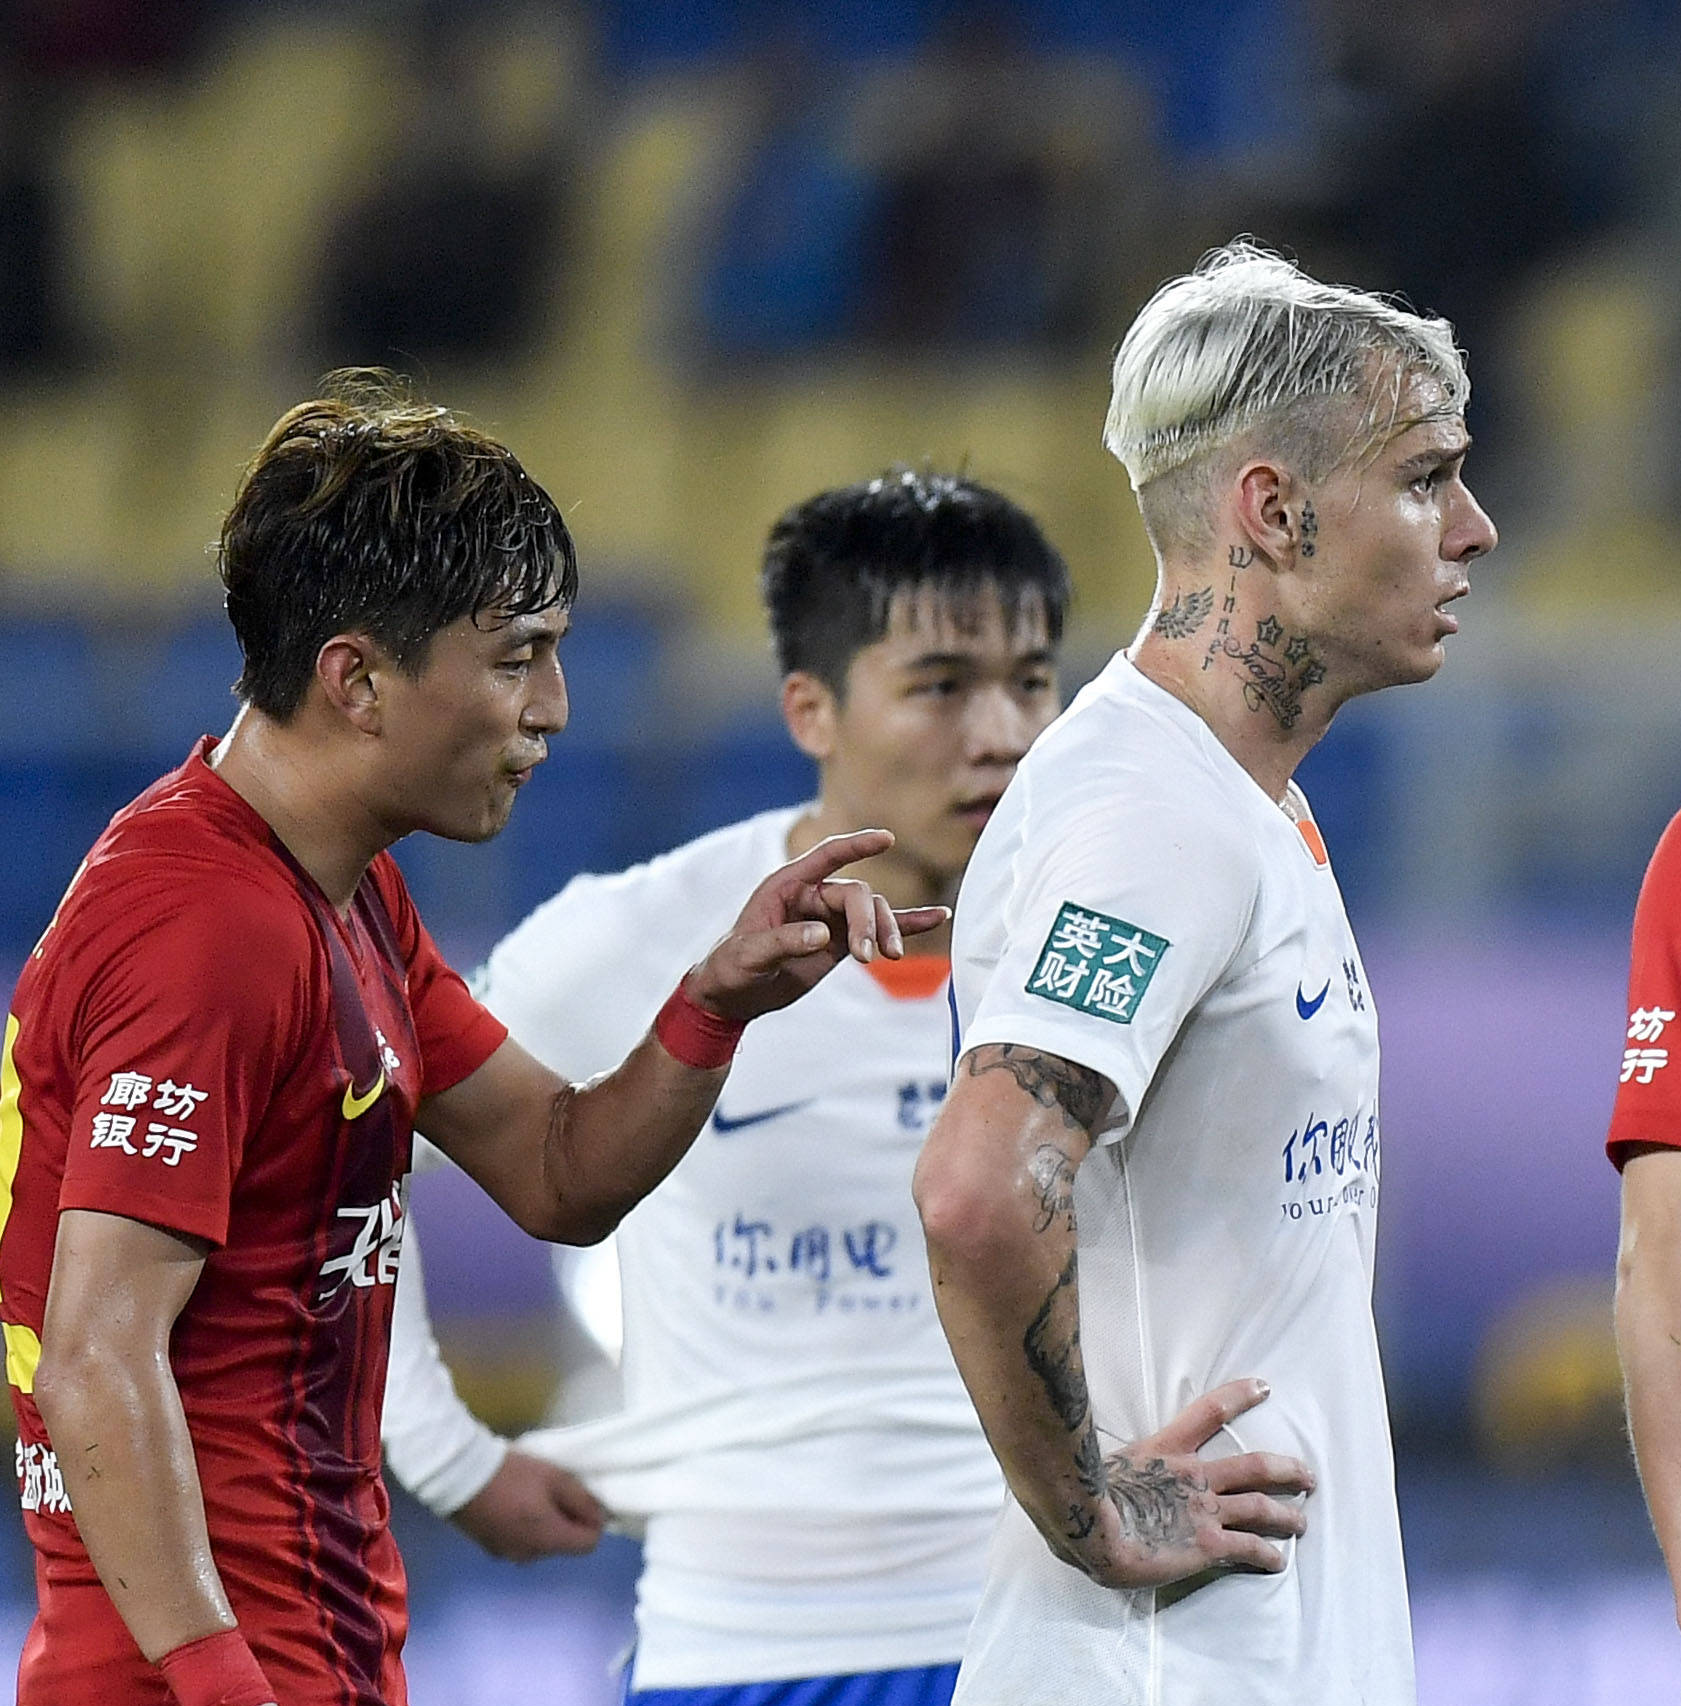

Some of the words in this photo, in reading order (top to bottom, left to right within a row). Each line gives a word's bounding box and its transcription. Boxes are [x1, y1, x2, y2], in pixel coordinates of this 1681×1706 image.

[1052, 911, 1156, 978] 英大
[1033, 951, 1137, 1018] 财险
[1620, 1049, 1669, 1084] 行
[100, 1071, 209, 1121] 廊坊
[90, 1112, 199, 1166] 银行
